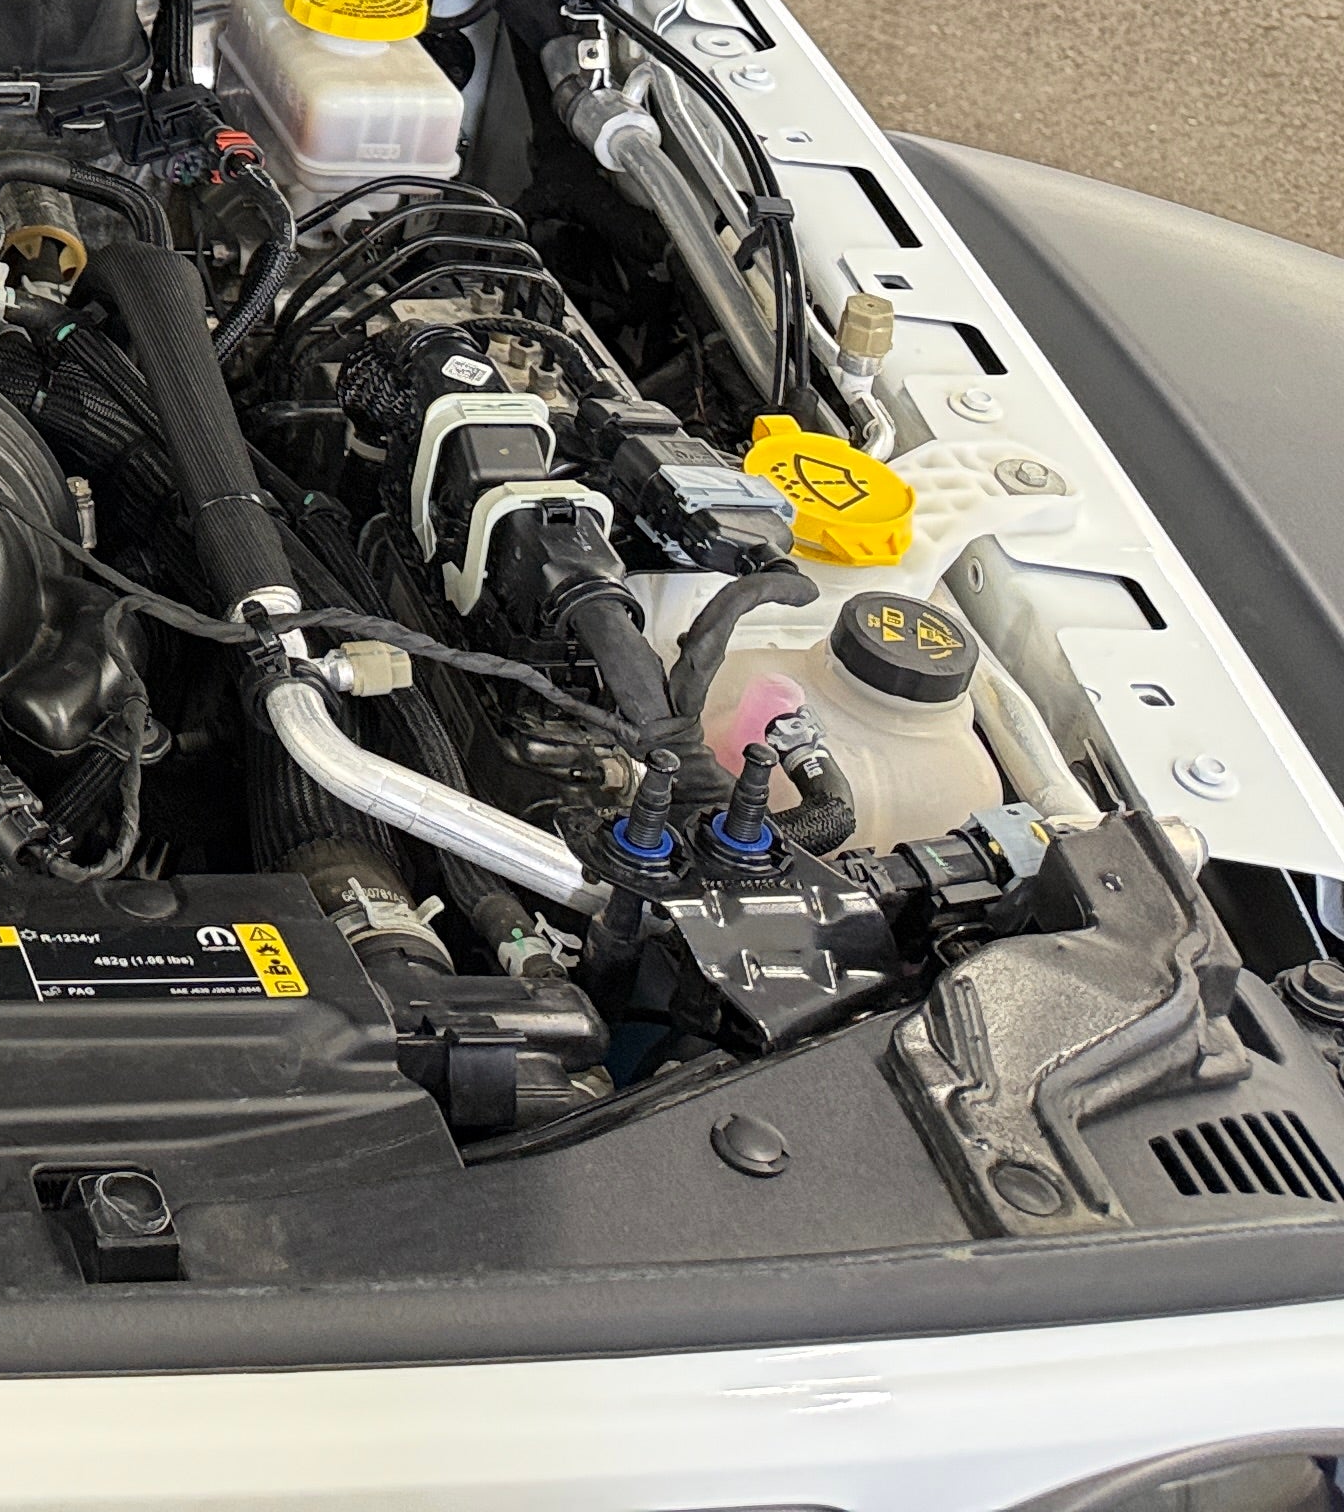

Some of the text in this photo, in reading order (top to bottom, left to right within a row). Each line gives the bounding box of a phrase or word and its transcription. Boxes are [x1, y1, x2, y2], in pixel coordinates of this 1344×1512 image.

[39, 933, 101, 945] R-1234yf
[94, 956, 129, 967] 482g
[166, 955, 195, 966] lbs)
[67, 986, 96, 996] PAG
